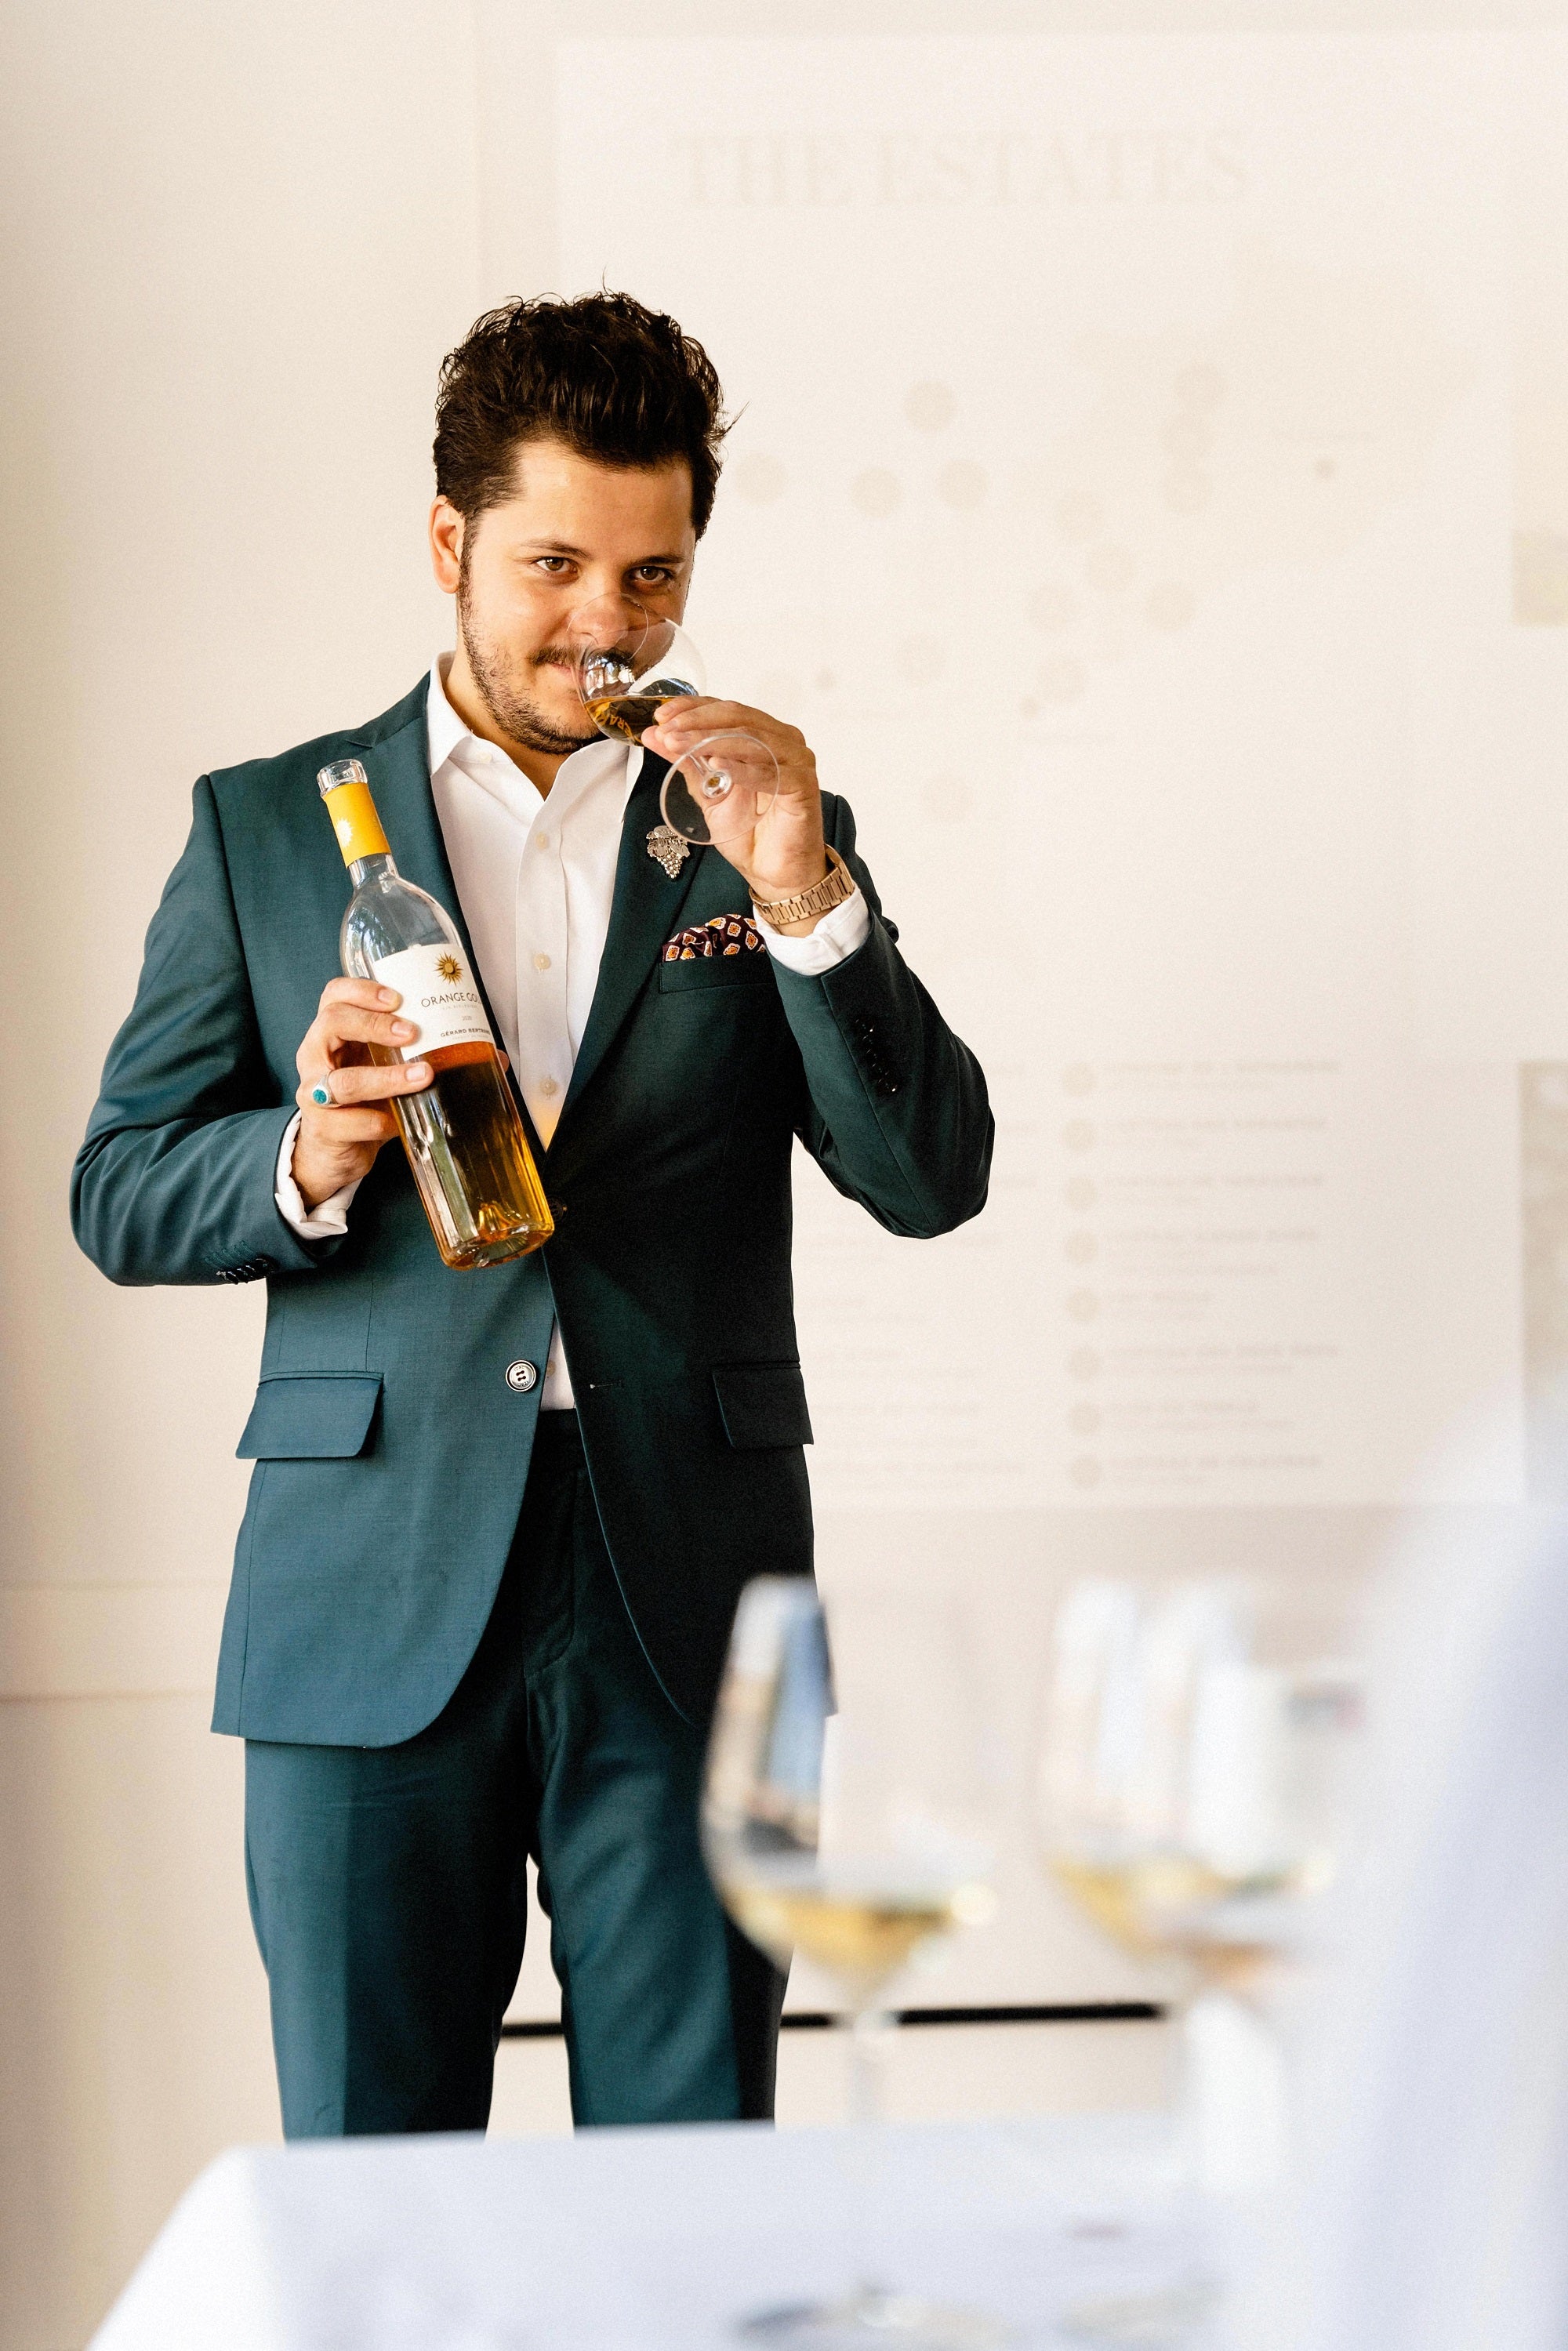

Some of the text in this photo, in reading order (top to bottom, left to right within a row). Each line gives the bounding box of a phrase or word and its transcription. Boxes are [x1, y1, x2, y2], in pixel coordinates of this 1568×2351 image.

[666, 128, 1252, 209] THE ESTATES
[421, 992, 465, 1007] ORANGE
